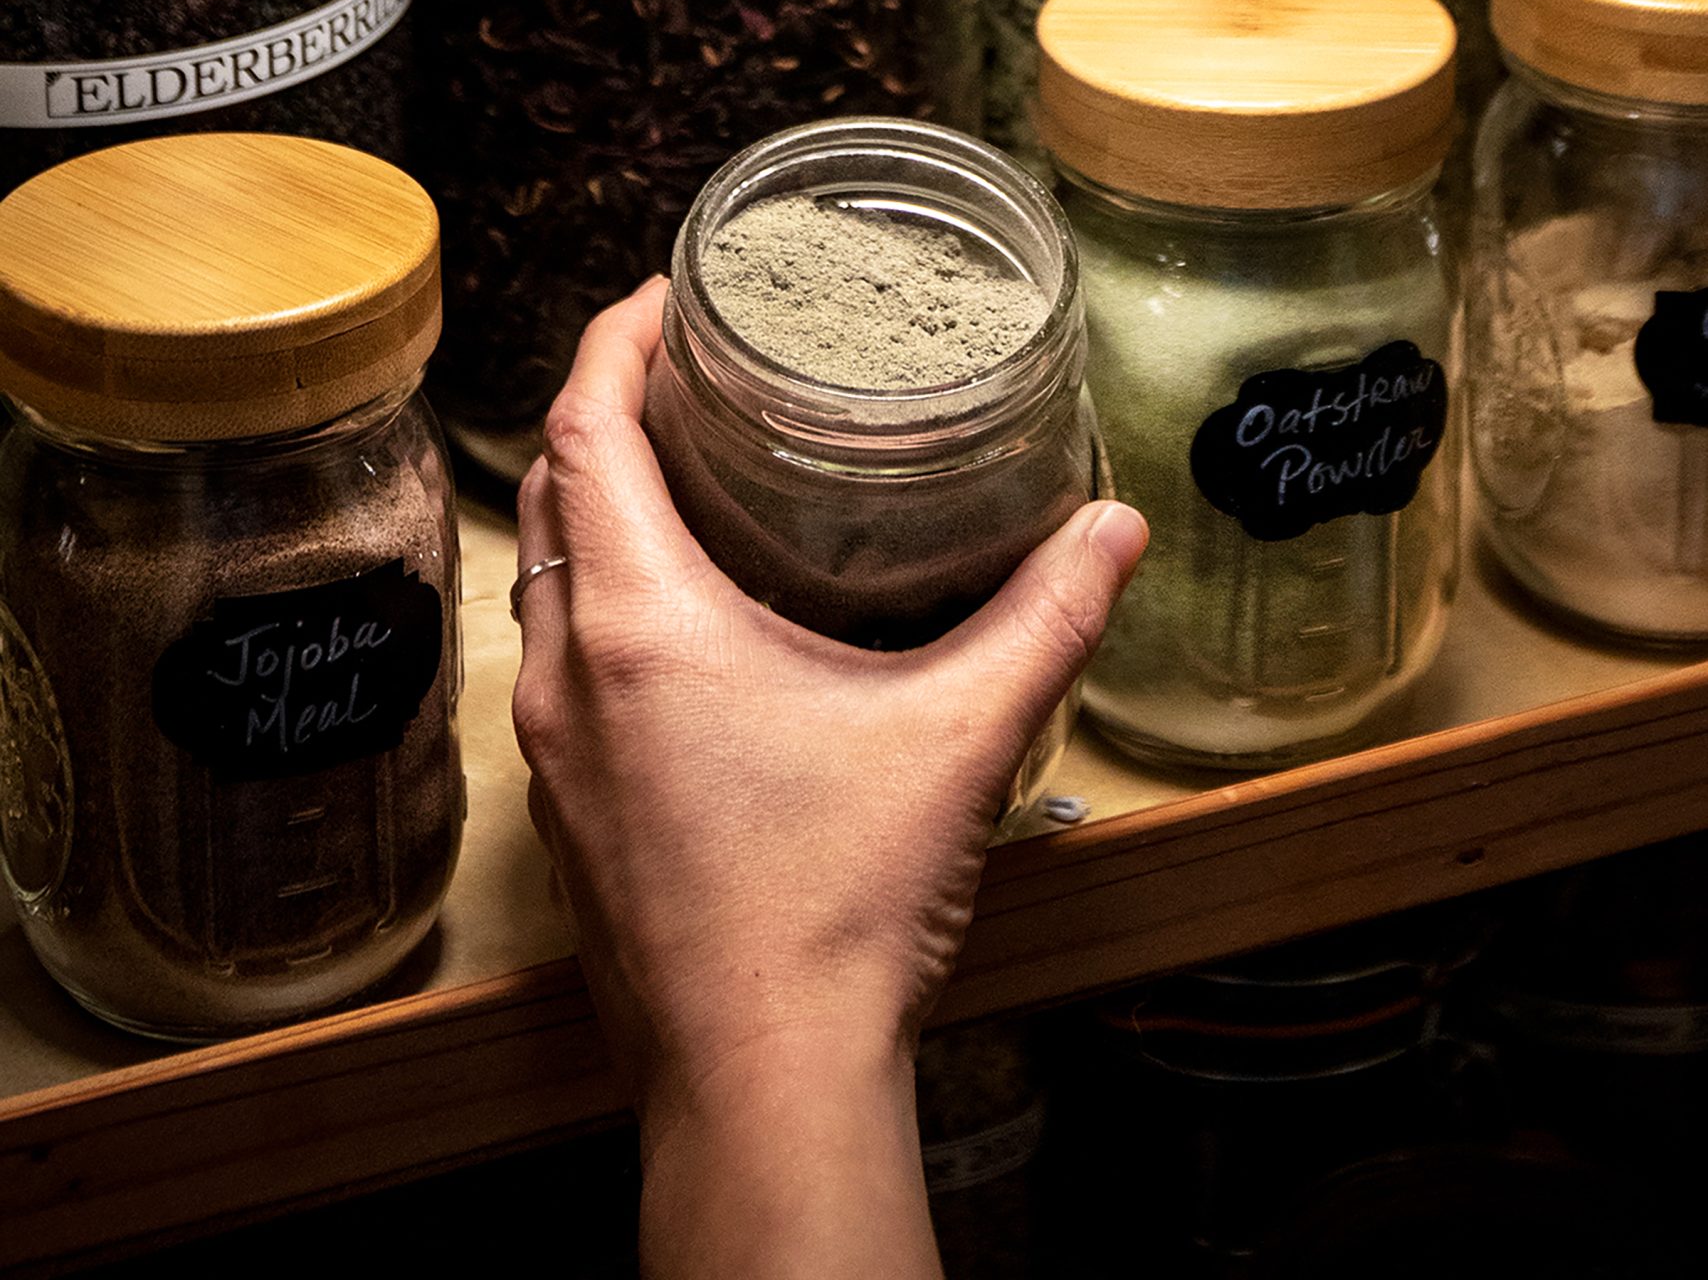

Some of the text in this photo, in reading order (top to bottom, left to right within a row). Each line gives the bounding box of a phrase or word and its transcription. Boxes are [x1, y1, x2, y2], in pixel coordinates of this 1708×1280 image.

[1260, 425, 1432, 506] Powder
[206, 616, 392, 703] Jojoba
[246, 672, 377, 753] Meal
